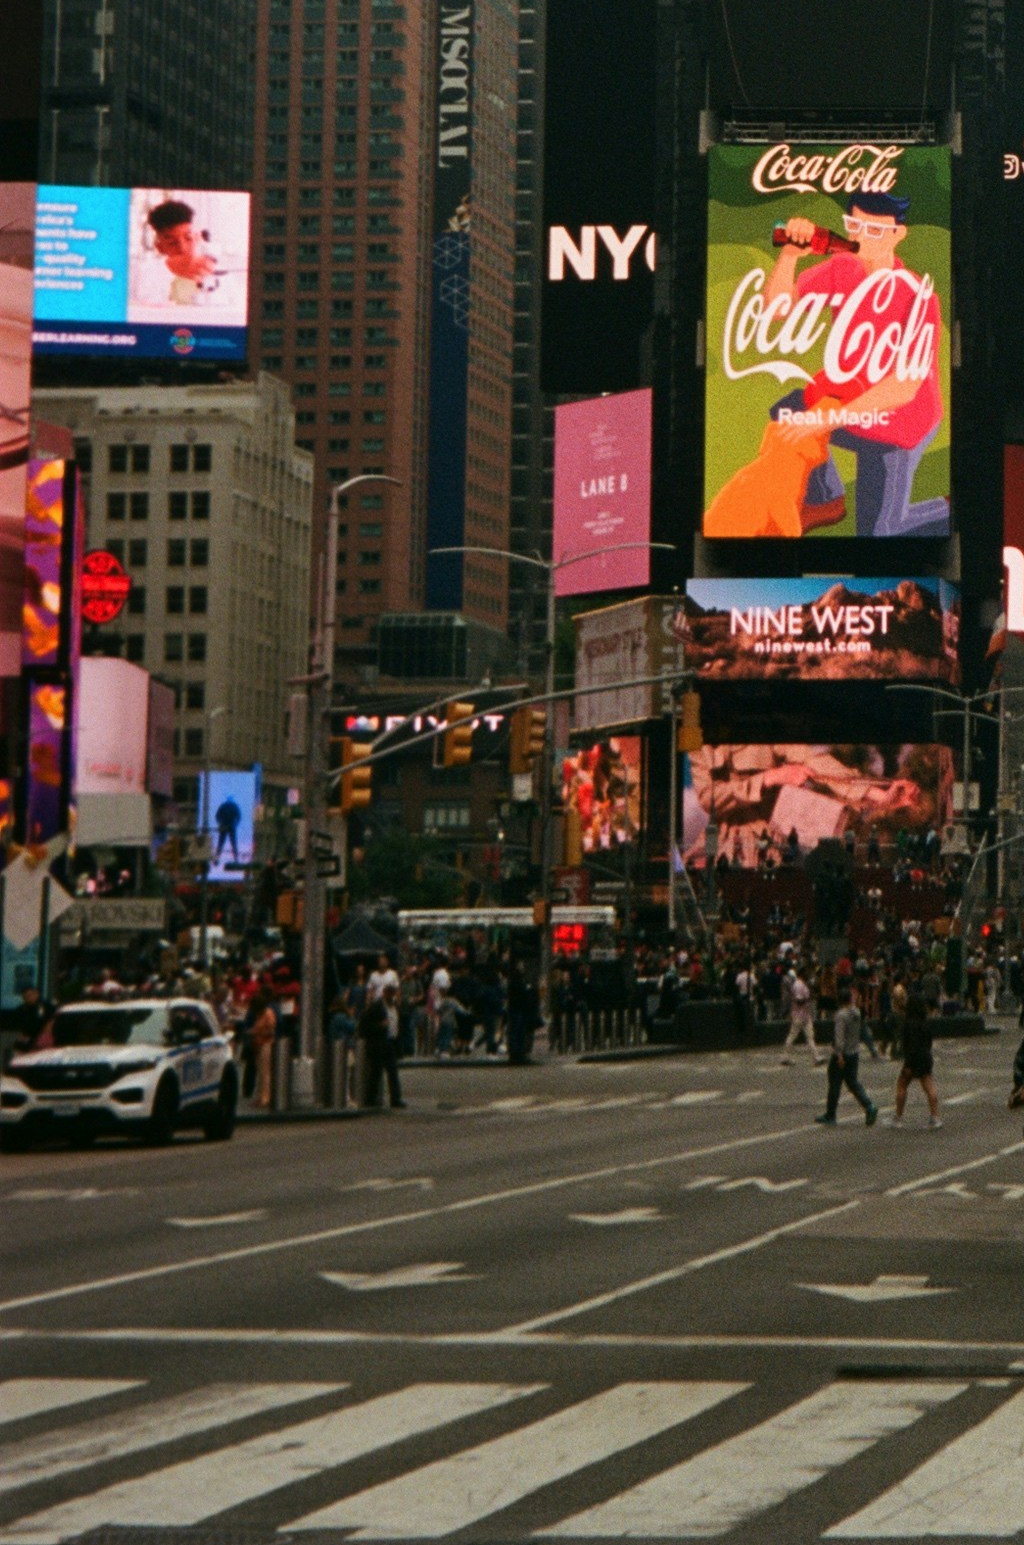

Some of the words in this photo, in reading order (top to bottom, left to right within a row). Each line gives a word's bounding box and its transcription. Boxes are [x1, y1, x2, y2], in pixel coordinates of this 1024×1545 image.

[752, 143, 904, 194] Coca-Cola
[548, 225, 656, 281] NY
[723, 267, 936, 386] Coca-Cola
[777, 407, 822, 426] Real
[827, 407, 891, 429] Magic
[580, 474, 615, 498] LANE
[730, 605, 802, 636] NINE
[811, 604, 895, 636] WEST
[753, 637, 873, 655] ninewest.com
